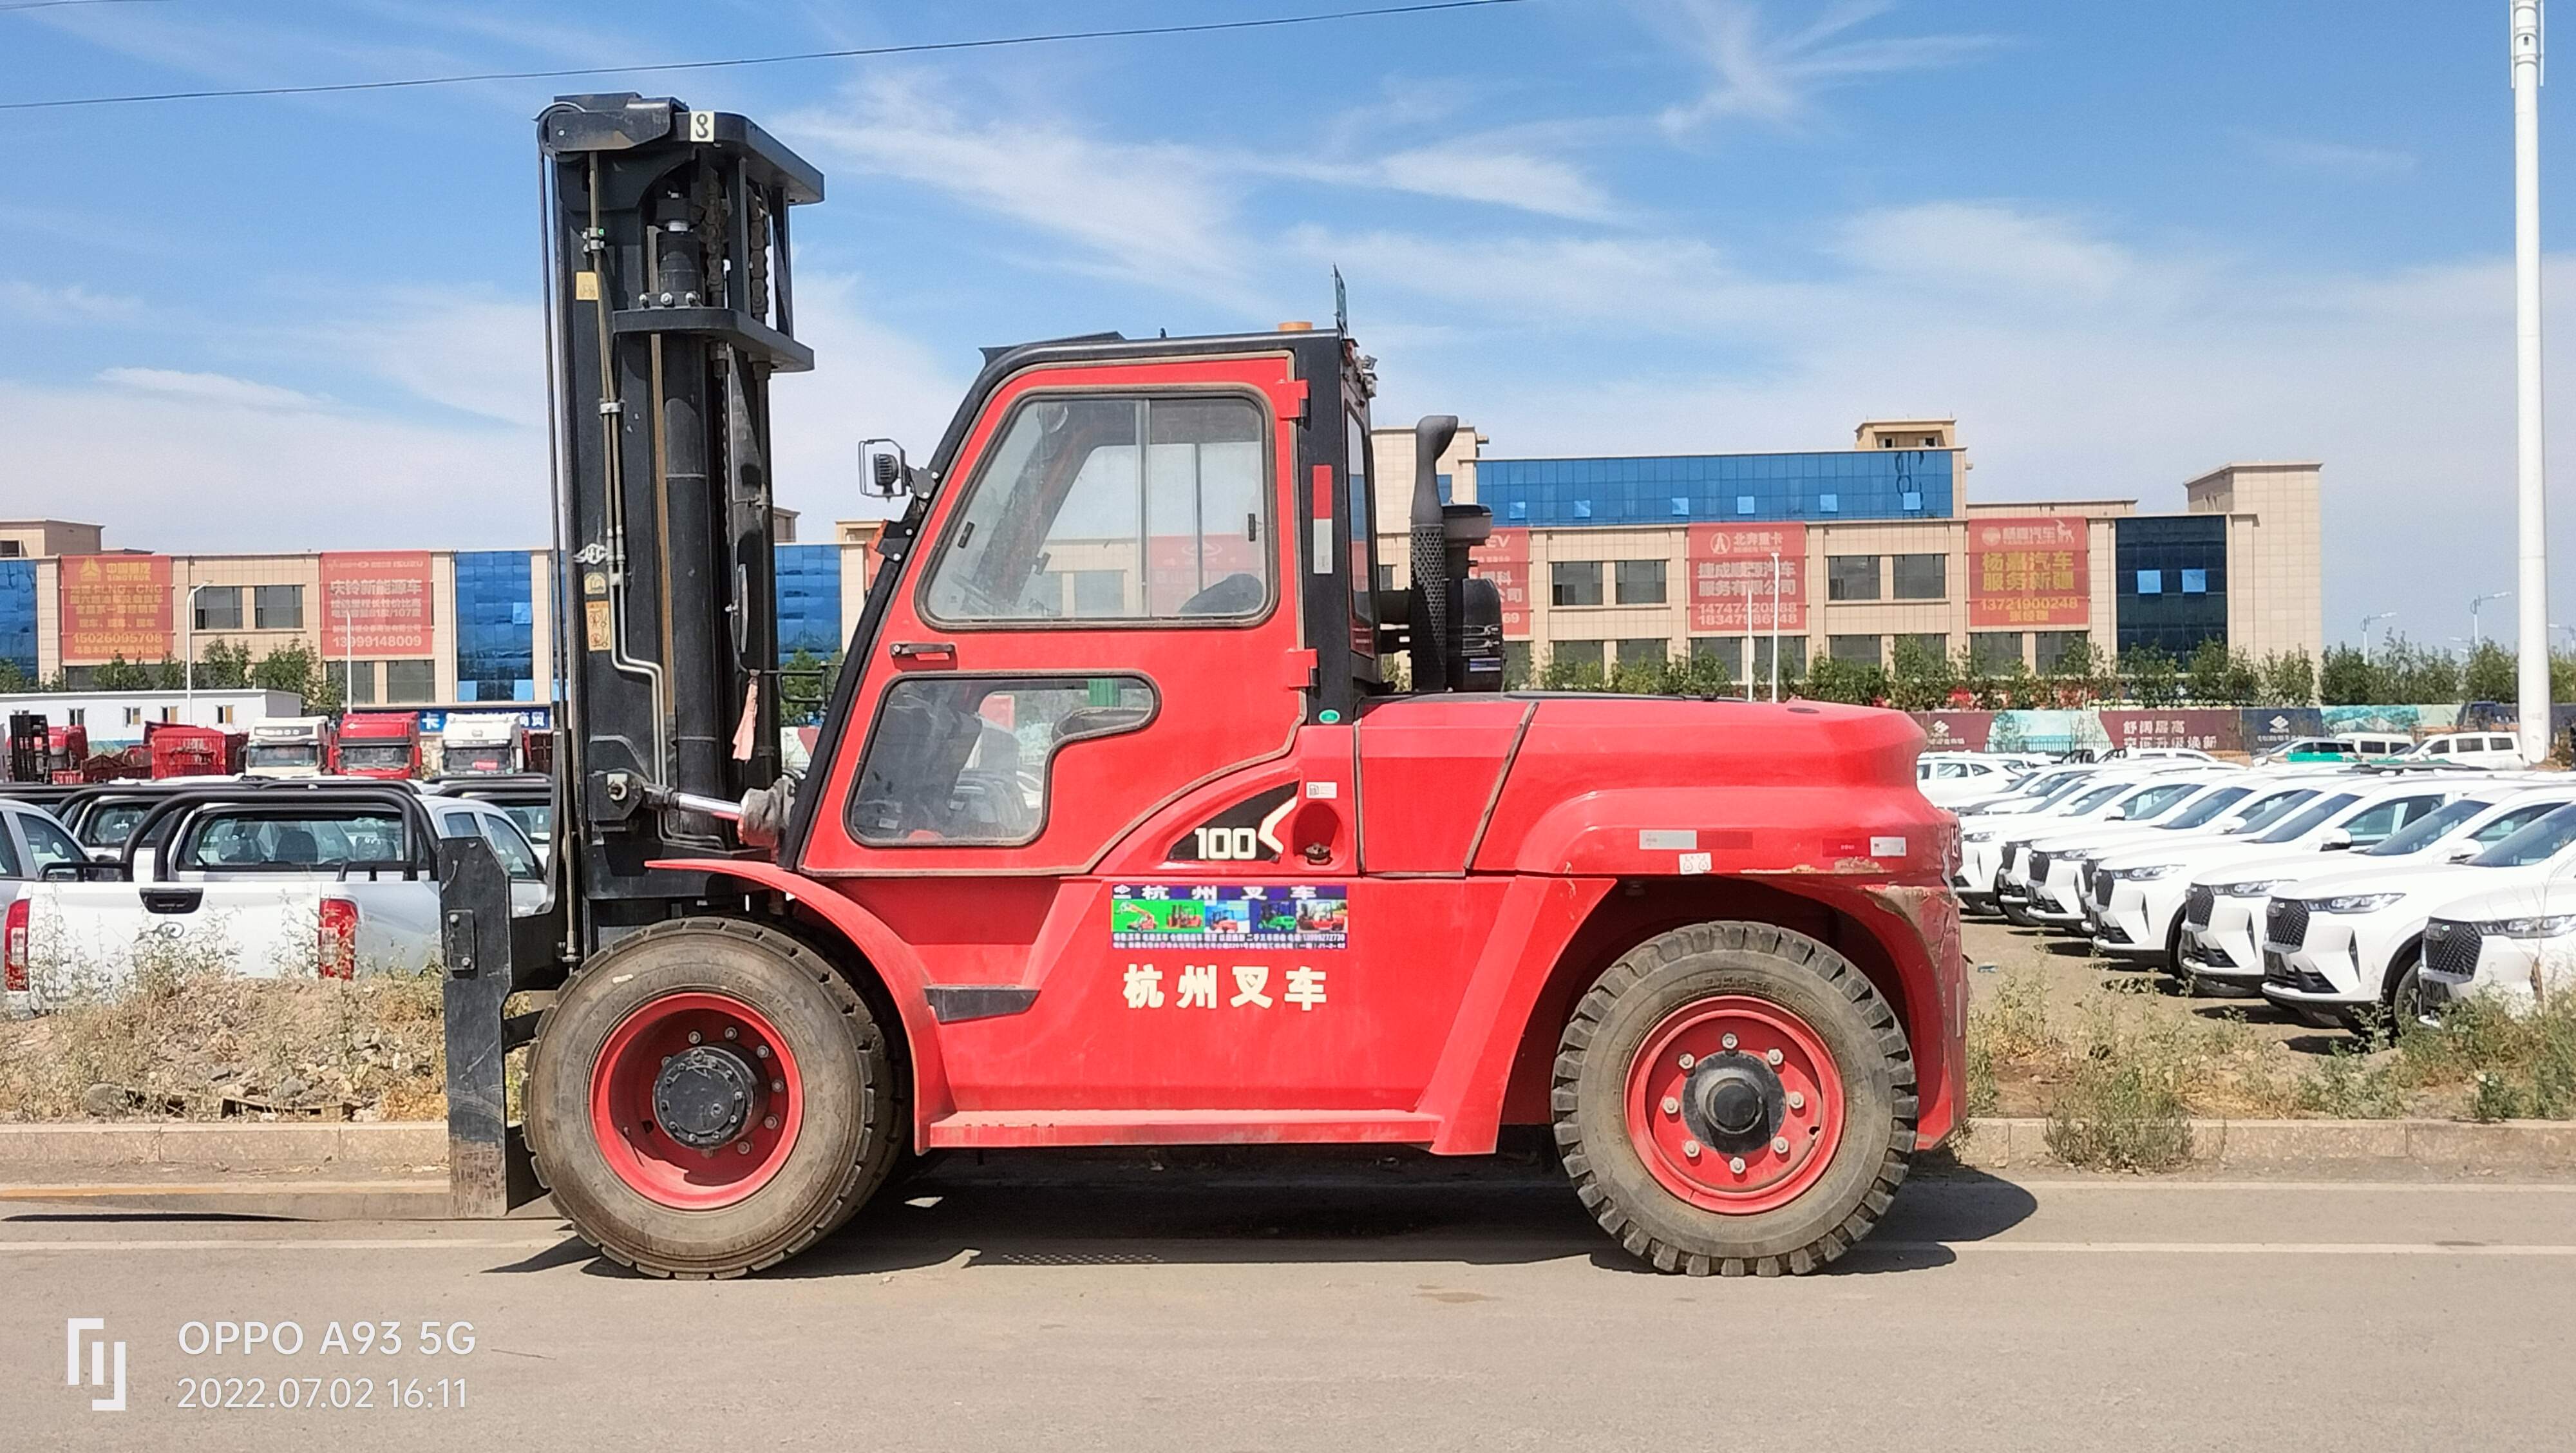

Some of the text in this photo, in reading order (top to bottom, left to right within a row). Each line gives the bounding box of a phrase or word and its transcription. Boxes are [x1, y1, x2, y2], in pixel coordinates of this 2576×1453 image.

[1733, 531, 1783, 546] 北奔重卡
[1982, 551, 2074, 571] 杨嘉汽车
[1982, 571, 2074, 591] 服务新疆
[422, 712, 440, 729] 卡
[1195, 828, 1256, 859] 100
[1141, 886, 1318, 901] 杭州叉车
[1123, 964, 1327, 1011] 杭州叉车
